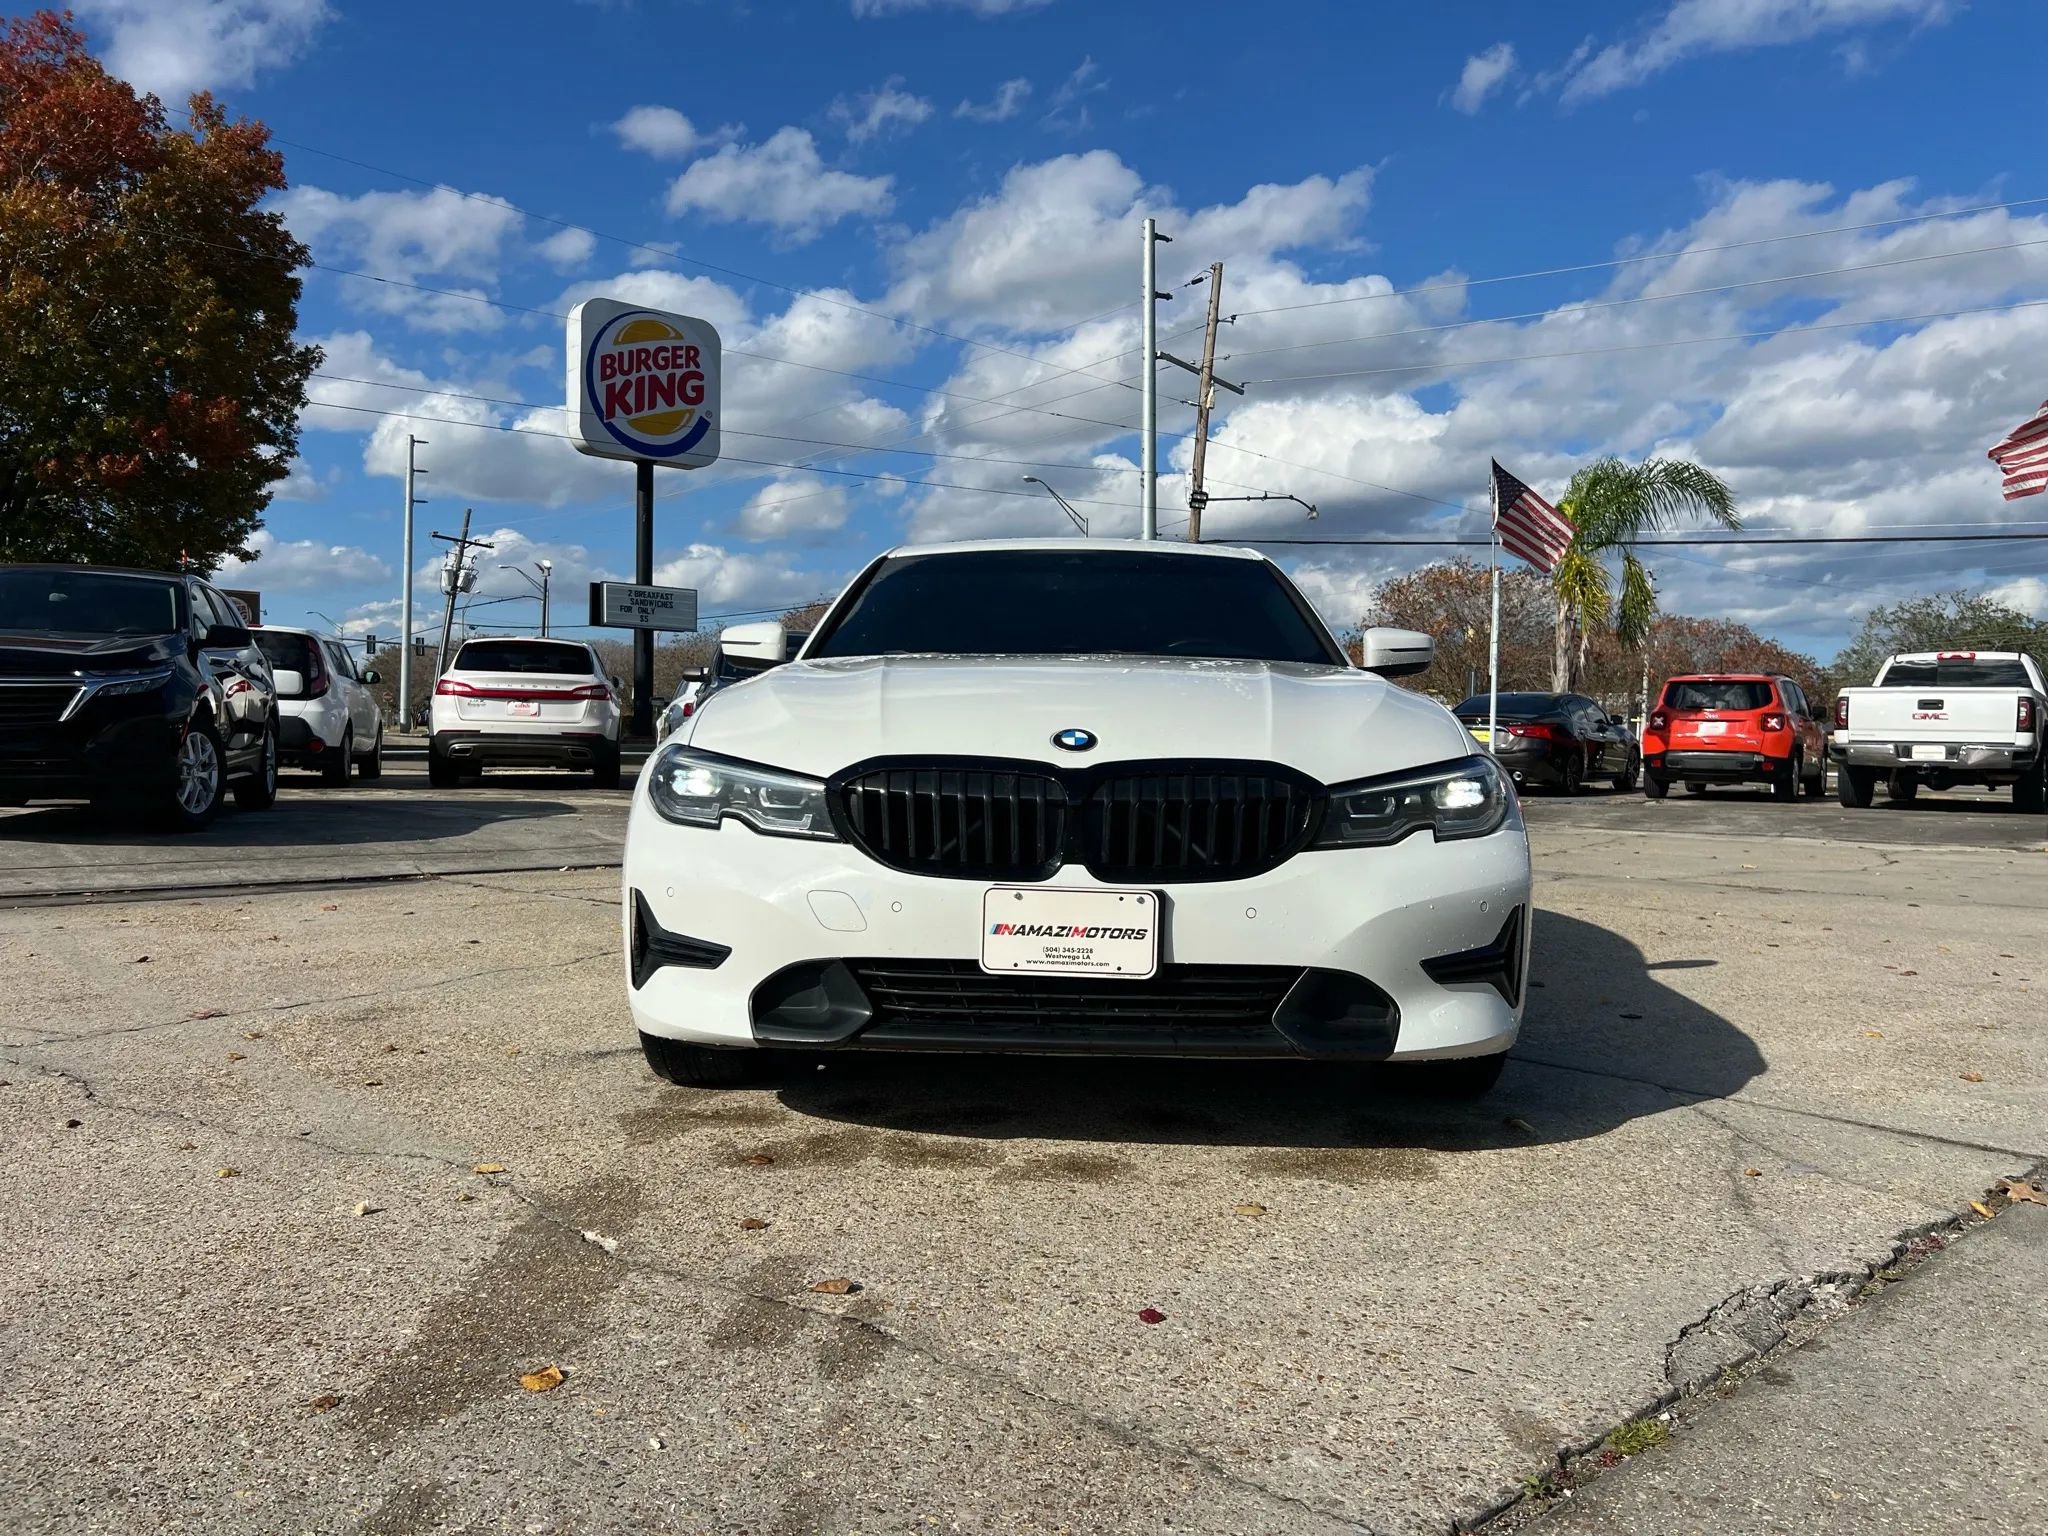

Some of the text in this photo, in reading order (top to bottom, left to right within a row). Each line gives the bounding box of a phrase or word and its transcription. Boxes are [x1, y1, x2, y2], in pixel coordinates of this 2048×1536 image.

[600, 345, 701, 382] BURGER
[604, 370, 705, 421] KING
[630, 598, 674, 609] SANDWICHES
[619, 605, 656, 615] FOR ONLY
[639, 615, 649, 623] $5
[1912, 713, 1949, 721] GMC
[1042, 946, 1061, 954] (504)
[1025, 959, 1110, 967] www.namazimotors.com
